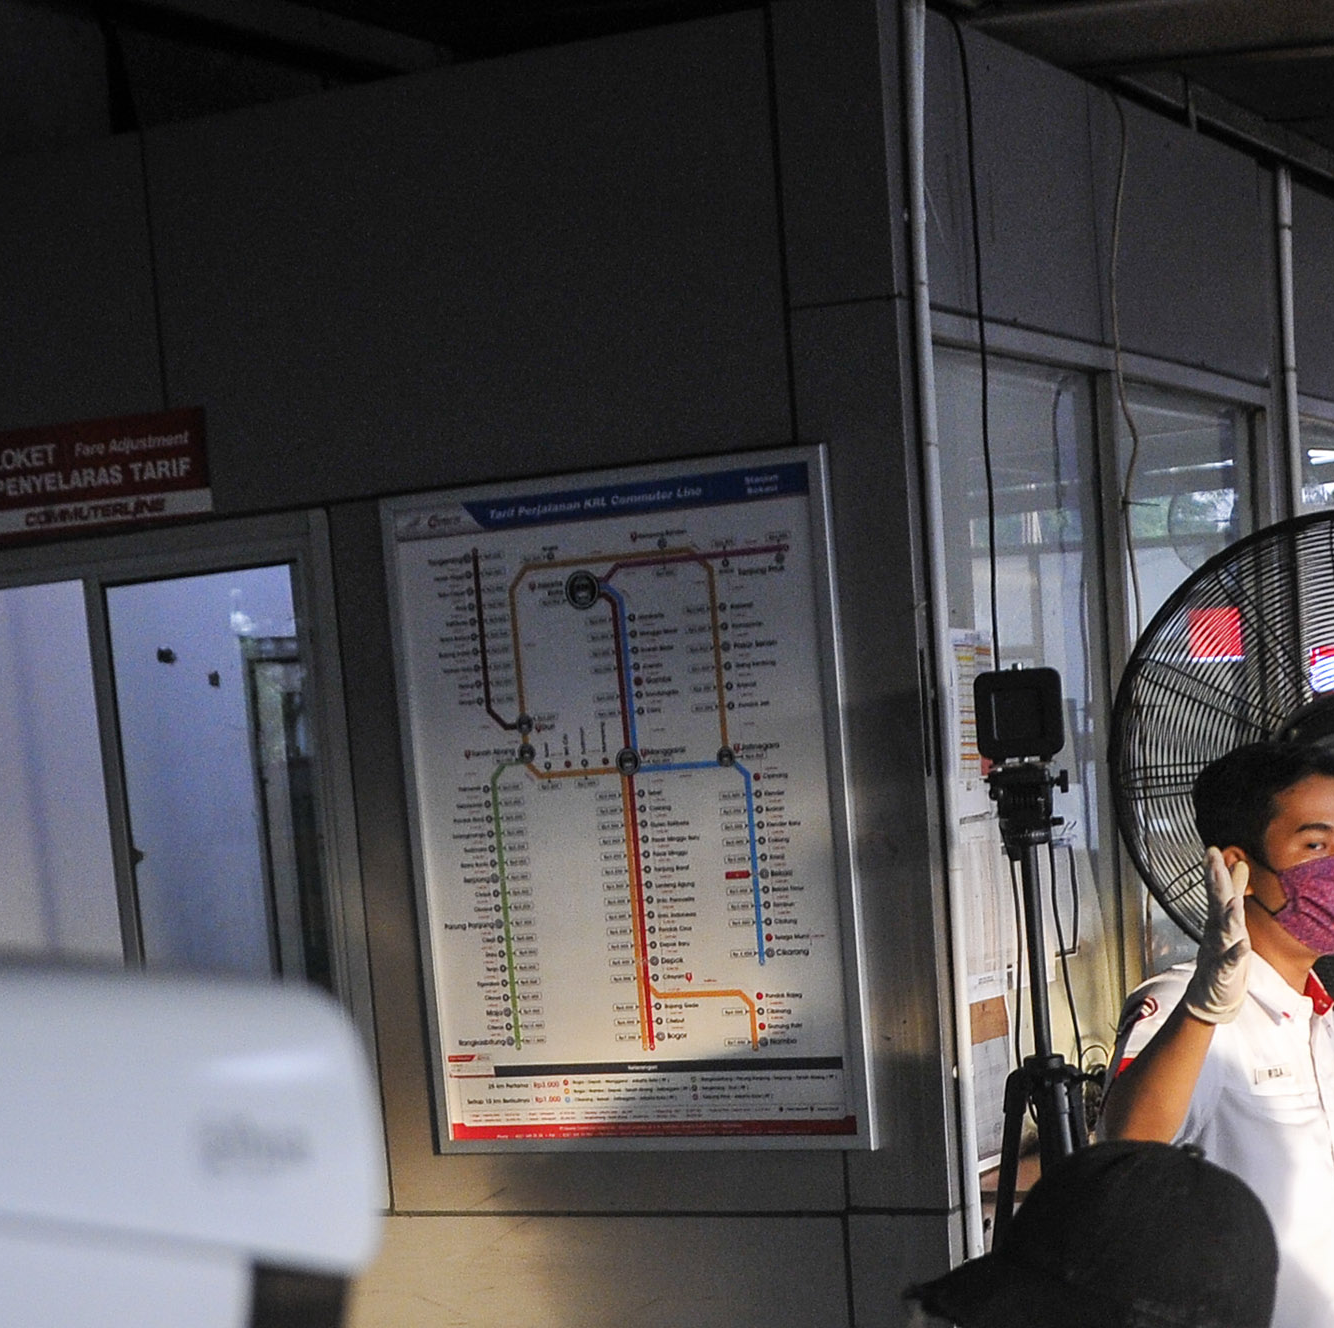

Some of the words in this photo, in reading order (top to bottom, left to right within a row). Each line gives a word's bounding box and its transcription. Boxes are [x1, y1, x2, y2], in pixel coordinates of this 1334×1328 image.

[74, 441, 106, 457] Fare
[108, 430, 189, 453] Adjustment
[129, 457, 193, 481] TARIF
